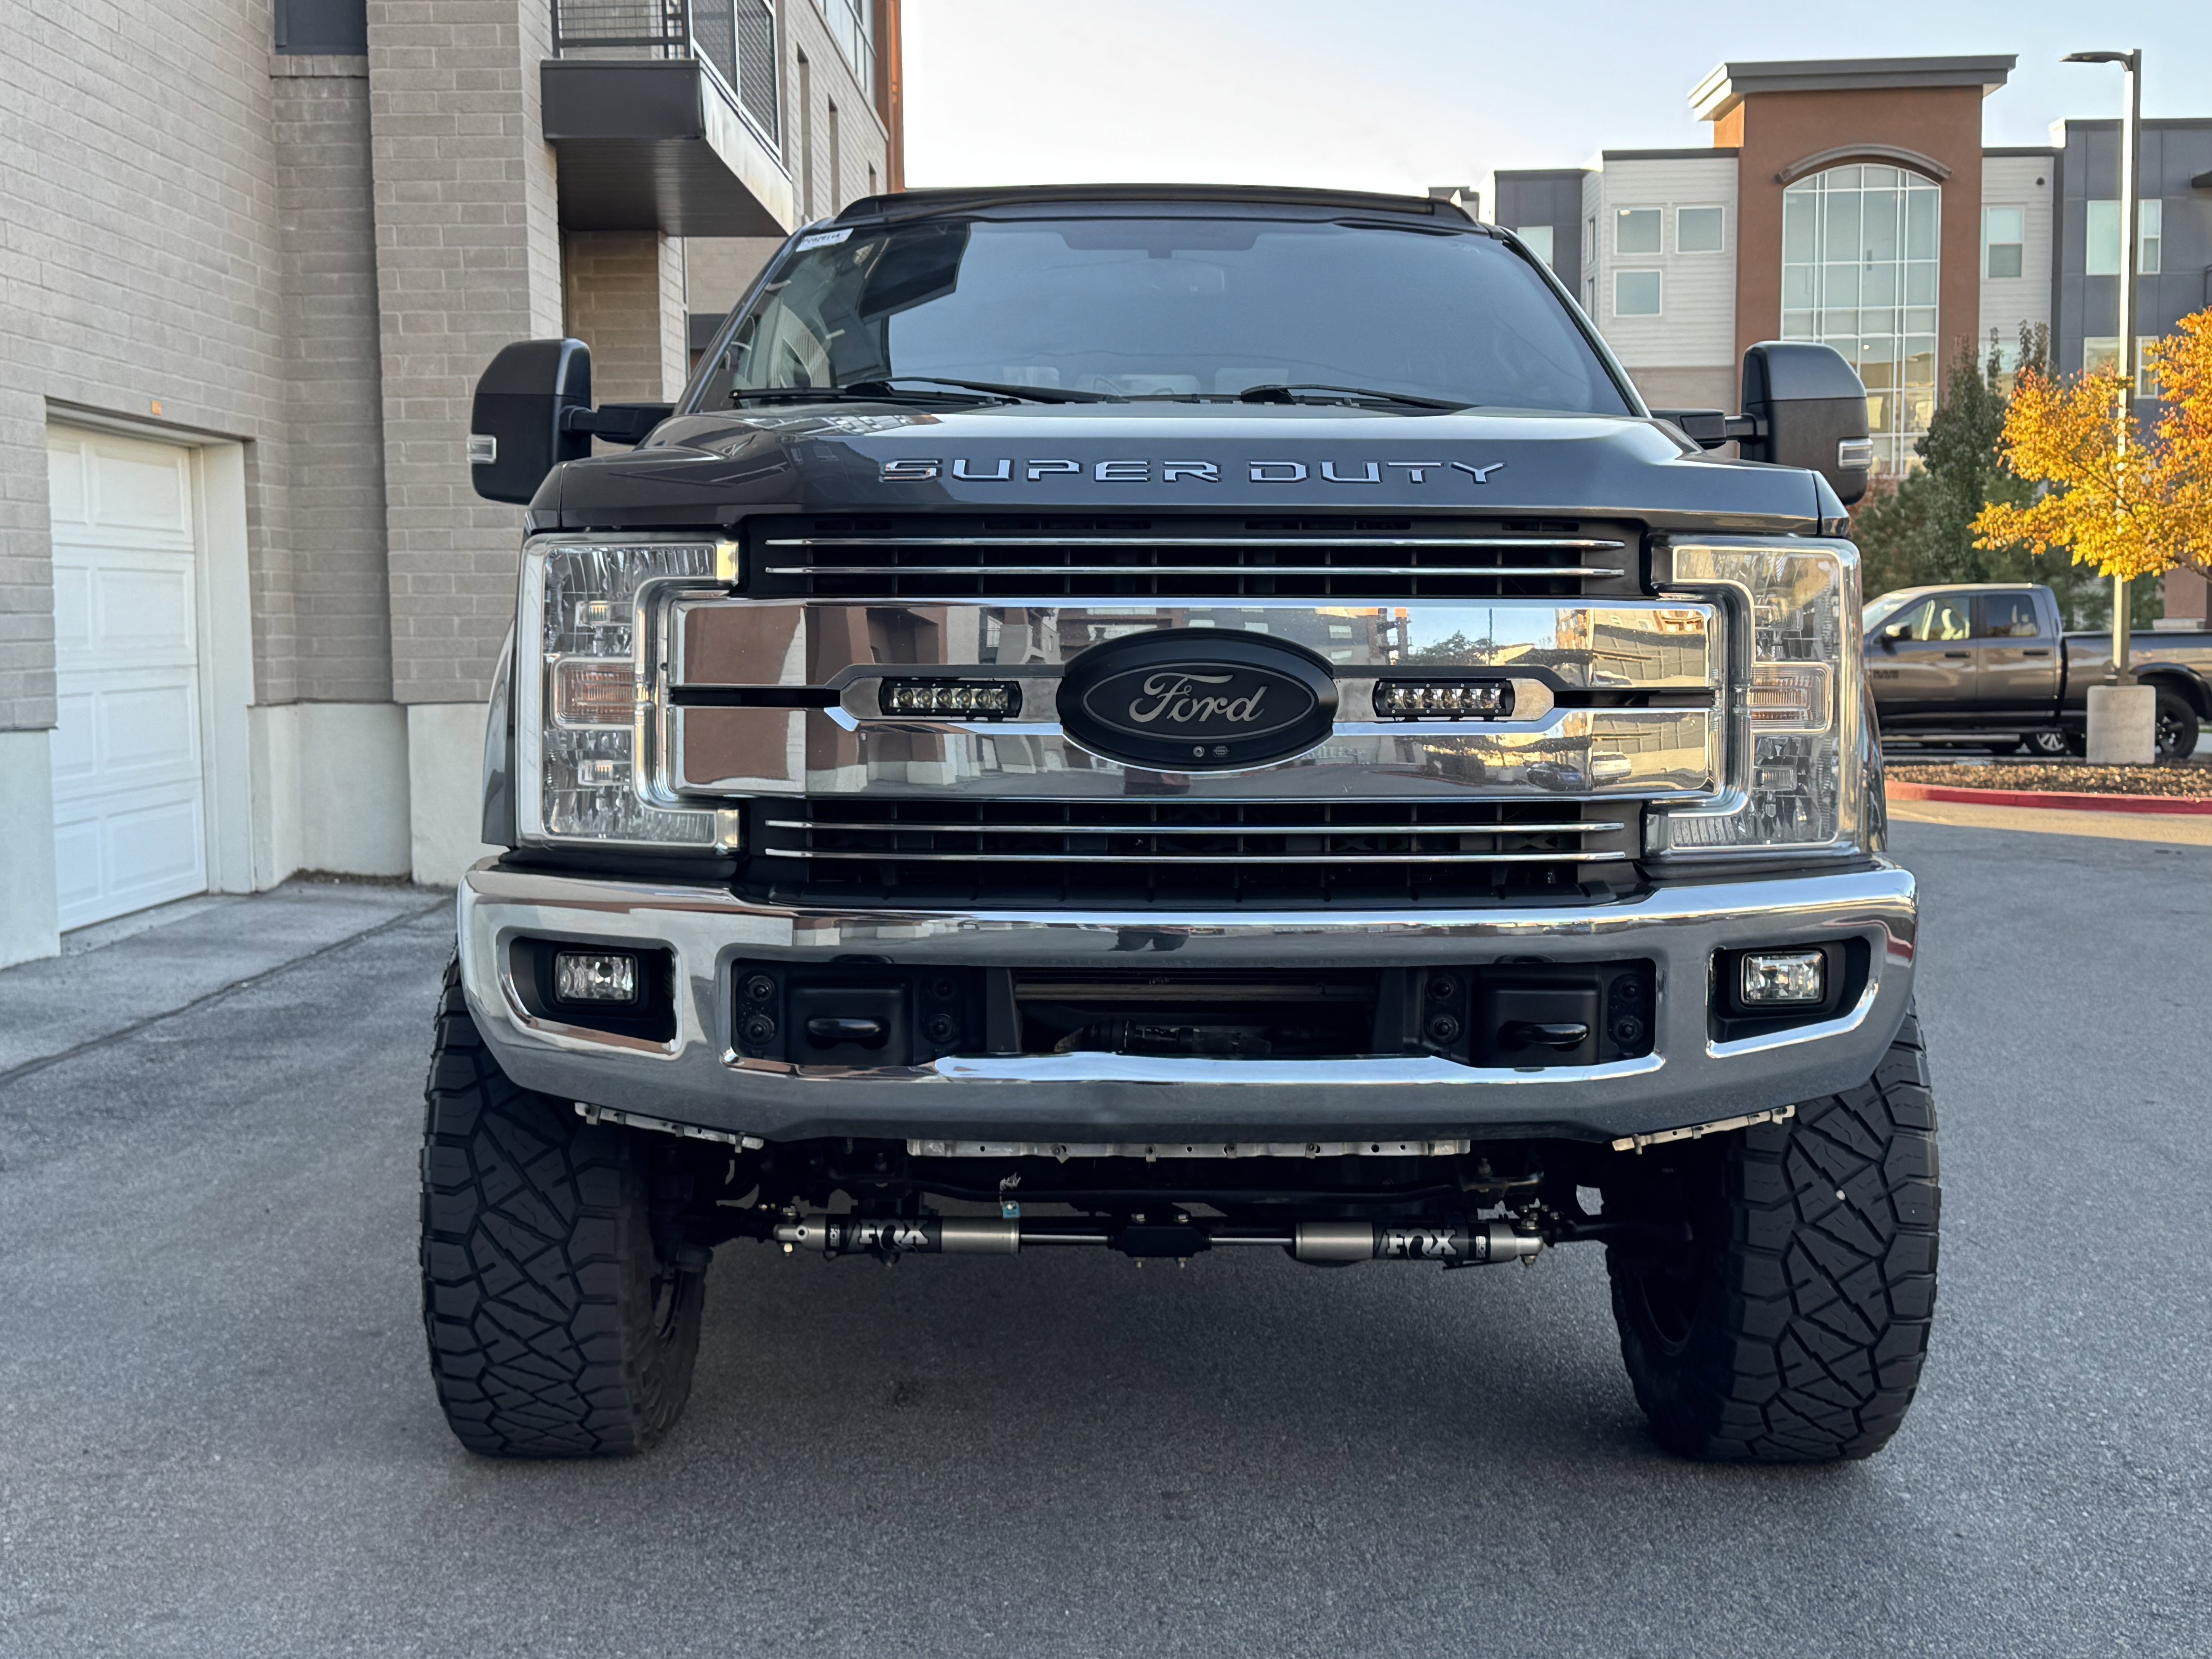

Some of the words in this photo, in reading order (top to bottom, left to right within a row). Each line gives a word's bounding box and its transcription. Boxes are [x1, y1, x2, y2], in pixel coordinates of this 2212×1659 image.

[879, 459, 1221, 483] SUPER
[1248, 460, 1506, 484] DUTY
[1128, 672, 1268, 722] Ford
[859, 1218, 928, 1252] FOX
[1387, 1228, 1457, 1259] FOX
